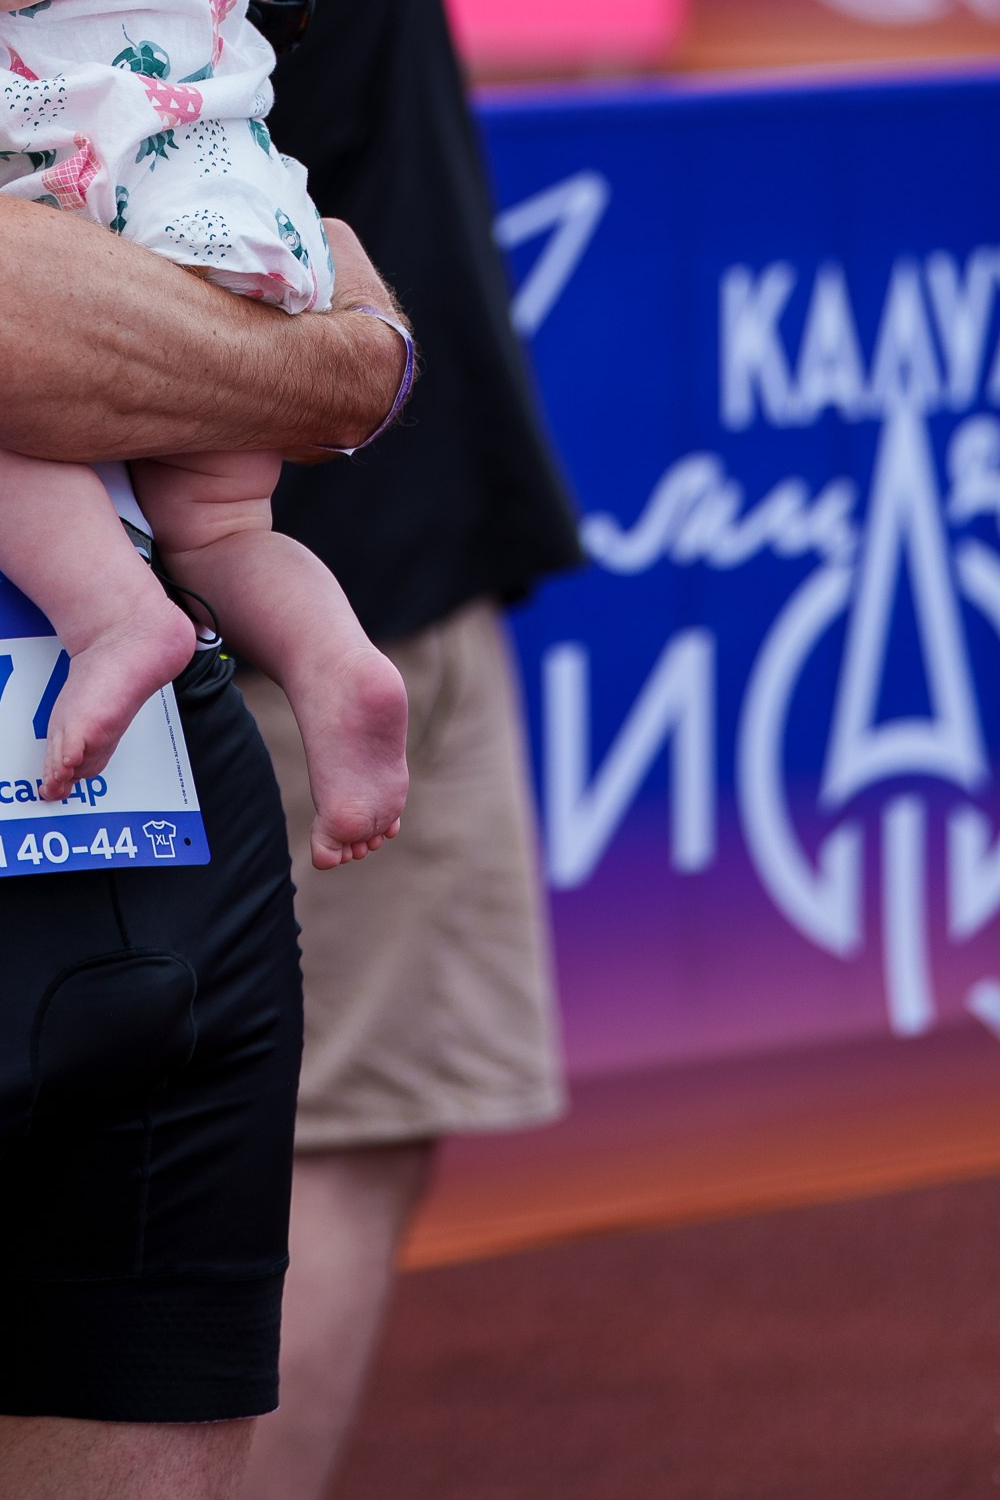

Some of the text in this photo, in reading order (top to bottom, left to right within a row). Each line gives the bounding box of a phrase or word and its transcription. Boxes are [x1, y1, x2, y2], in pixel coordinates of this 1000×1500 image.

[718, 245, 1000, 435] КАЛУ
[16, 827, 138, 866] 40-44
[155, 834, 170, 846] XL
